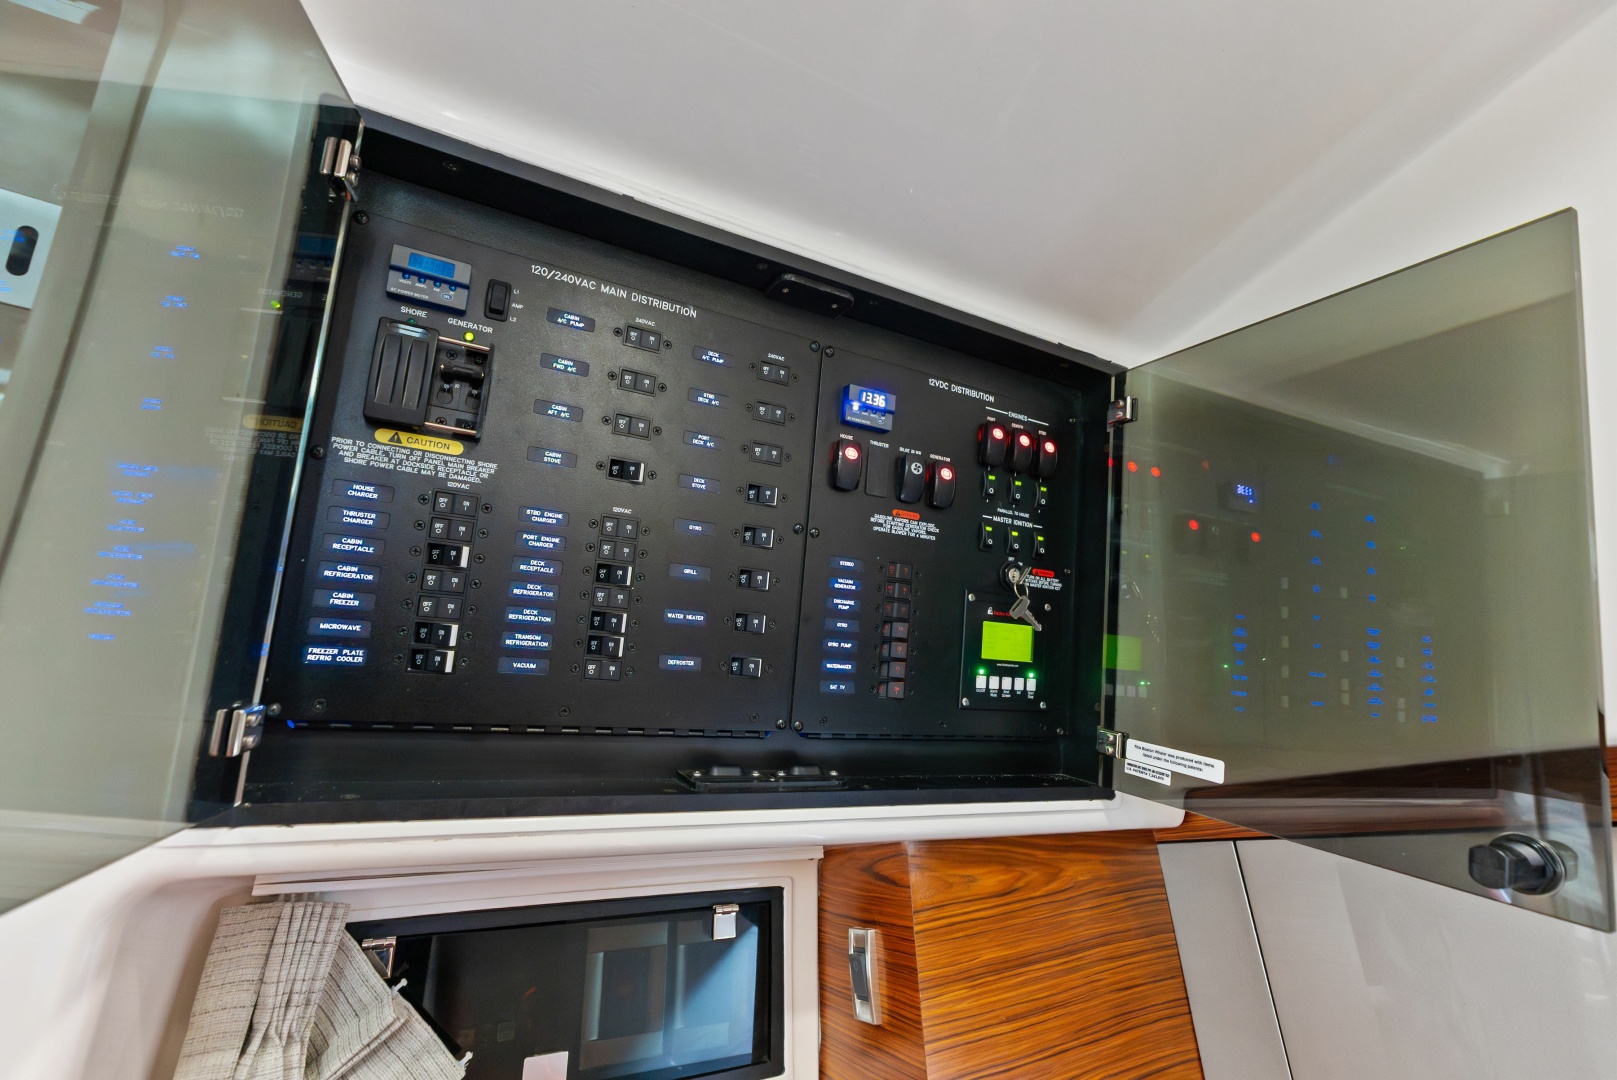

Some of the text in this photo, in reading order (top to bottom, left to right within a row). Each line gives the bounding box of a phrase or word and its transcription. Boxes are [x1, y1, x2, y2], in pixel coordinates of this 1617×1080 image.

[531, 265, 697, 318] 120/240VAC MAIN DISTRIBUTION
[400, 306, 428, 318] SHORE
[563, 313, 580, 321] CABIN
[447, 317, 493, 334] GENERATOR
[557, 317, 585, 328] A/C PUMP
[635, 317, 656, 327] 240VAC
[707, 350, 720, 358] DECK
[558, 358, 574, 366] CABIN
[928, 378, 995, 402] 12VDC DISTRIBUTION
[697, 396, 709, 404] DECK
[551, 404, 568, 412] CABIN
[1008, 411, 1028, 422] ENGINES
[406, 436, 450, 450] CAUTION
[692, 438, 705, 446] DECK
[870, 439, 889, 449] THRUSTER
[331, 436, 353, 446] PRIOR
[367, 442, 411, 455] CONNECTING
[413, 449, 423, 457] OR
[425, 451, 475, 466] DISCONNECTING
[477, 460, 498, 470] SHORE
[545, 451, 562, 459] CABIN
[332, 442, 359, 452] POWER
[389, 452, 407, 460] TURN
[424, 457, 445, 467] PANEL
[447, 461, 464, 470] MAIN
[466, 464, 495, 474] BREAKER
[543, 456, 561, 464] STOVE
[929, 453, 951, 463] GENERATOR
[338, 450, 354, 458] AND
[356, 452, 388, 463] BREAKER
[402, 460, 435, 471] DOCKSIDE
[437, 465, 477, 478] RECEPTACLE
[343, 456, 367, 466] SHORE
[369, 461, 394, 470] POWER
[396, 465, 419, 474] CABLE
[421, 469, 436, 477] MAY
[448, 473, 482, 484] DAMAGED.
[352, 484, 375, 492] HOUSE
[447, 481, 470, 490] 120VAC
[691, 482, 706, 490] STOVE
[347, 490, 378, 499] CHARGER
[342, 510, 376, 520] THRUSTER
[544, 511, 563, 519] ENGINE
[342, 516, 374, 526] CHARGER
[531, 516, 557, 524] CHARGER
[992, 515, 1033, 529] MASTER IGNITION
[341, 537, 363, 545] CABIN
[522, 533, 538, 541] PORT
[332, 543, 375, 553] RECEPTACLE
[519, 564, 554, 574] RECEPTACLE
[323, 570, 374, 580] REFRIGERATOR
[512, 588, 554, 597] REFRIGERATOR
[329, 599, 360, 607] FREEZER
[508, 613, 551, 622] REFRIGERATION
[686, 613, 704, 621] HEATER
[319, 623, 362, 631] MICROWAVE
[514, 633, 541, 641] TRANSOM
[505, 639, 549, 647] REFRIGERATION
[308, 647, 338, 655] FREEZER
